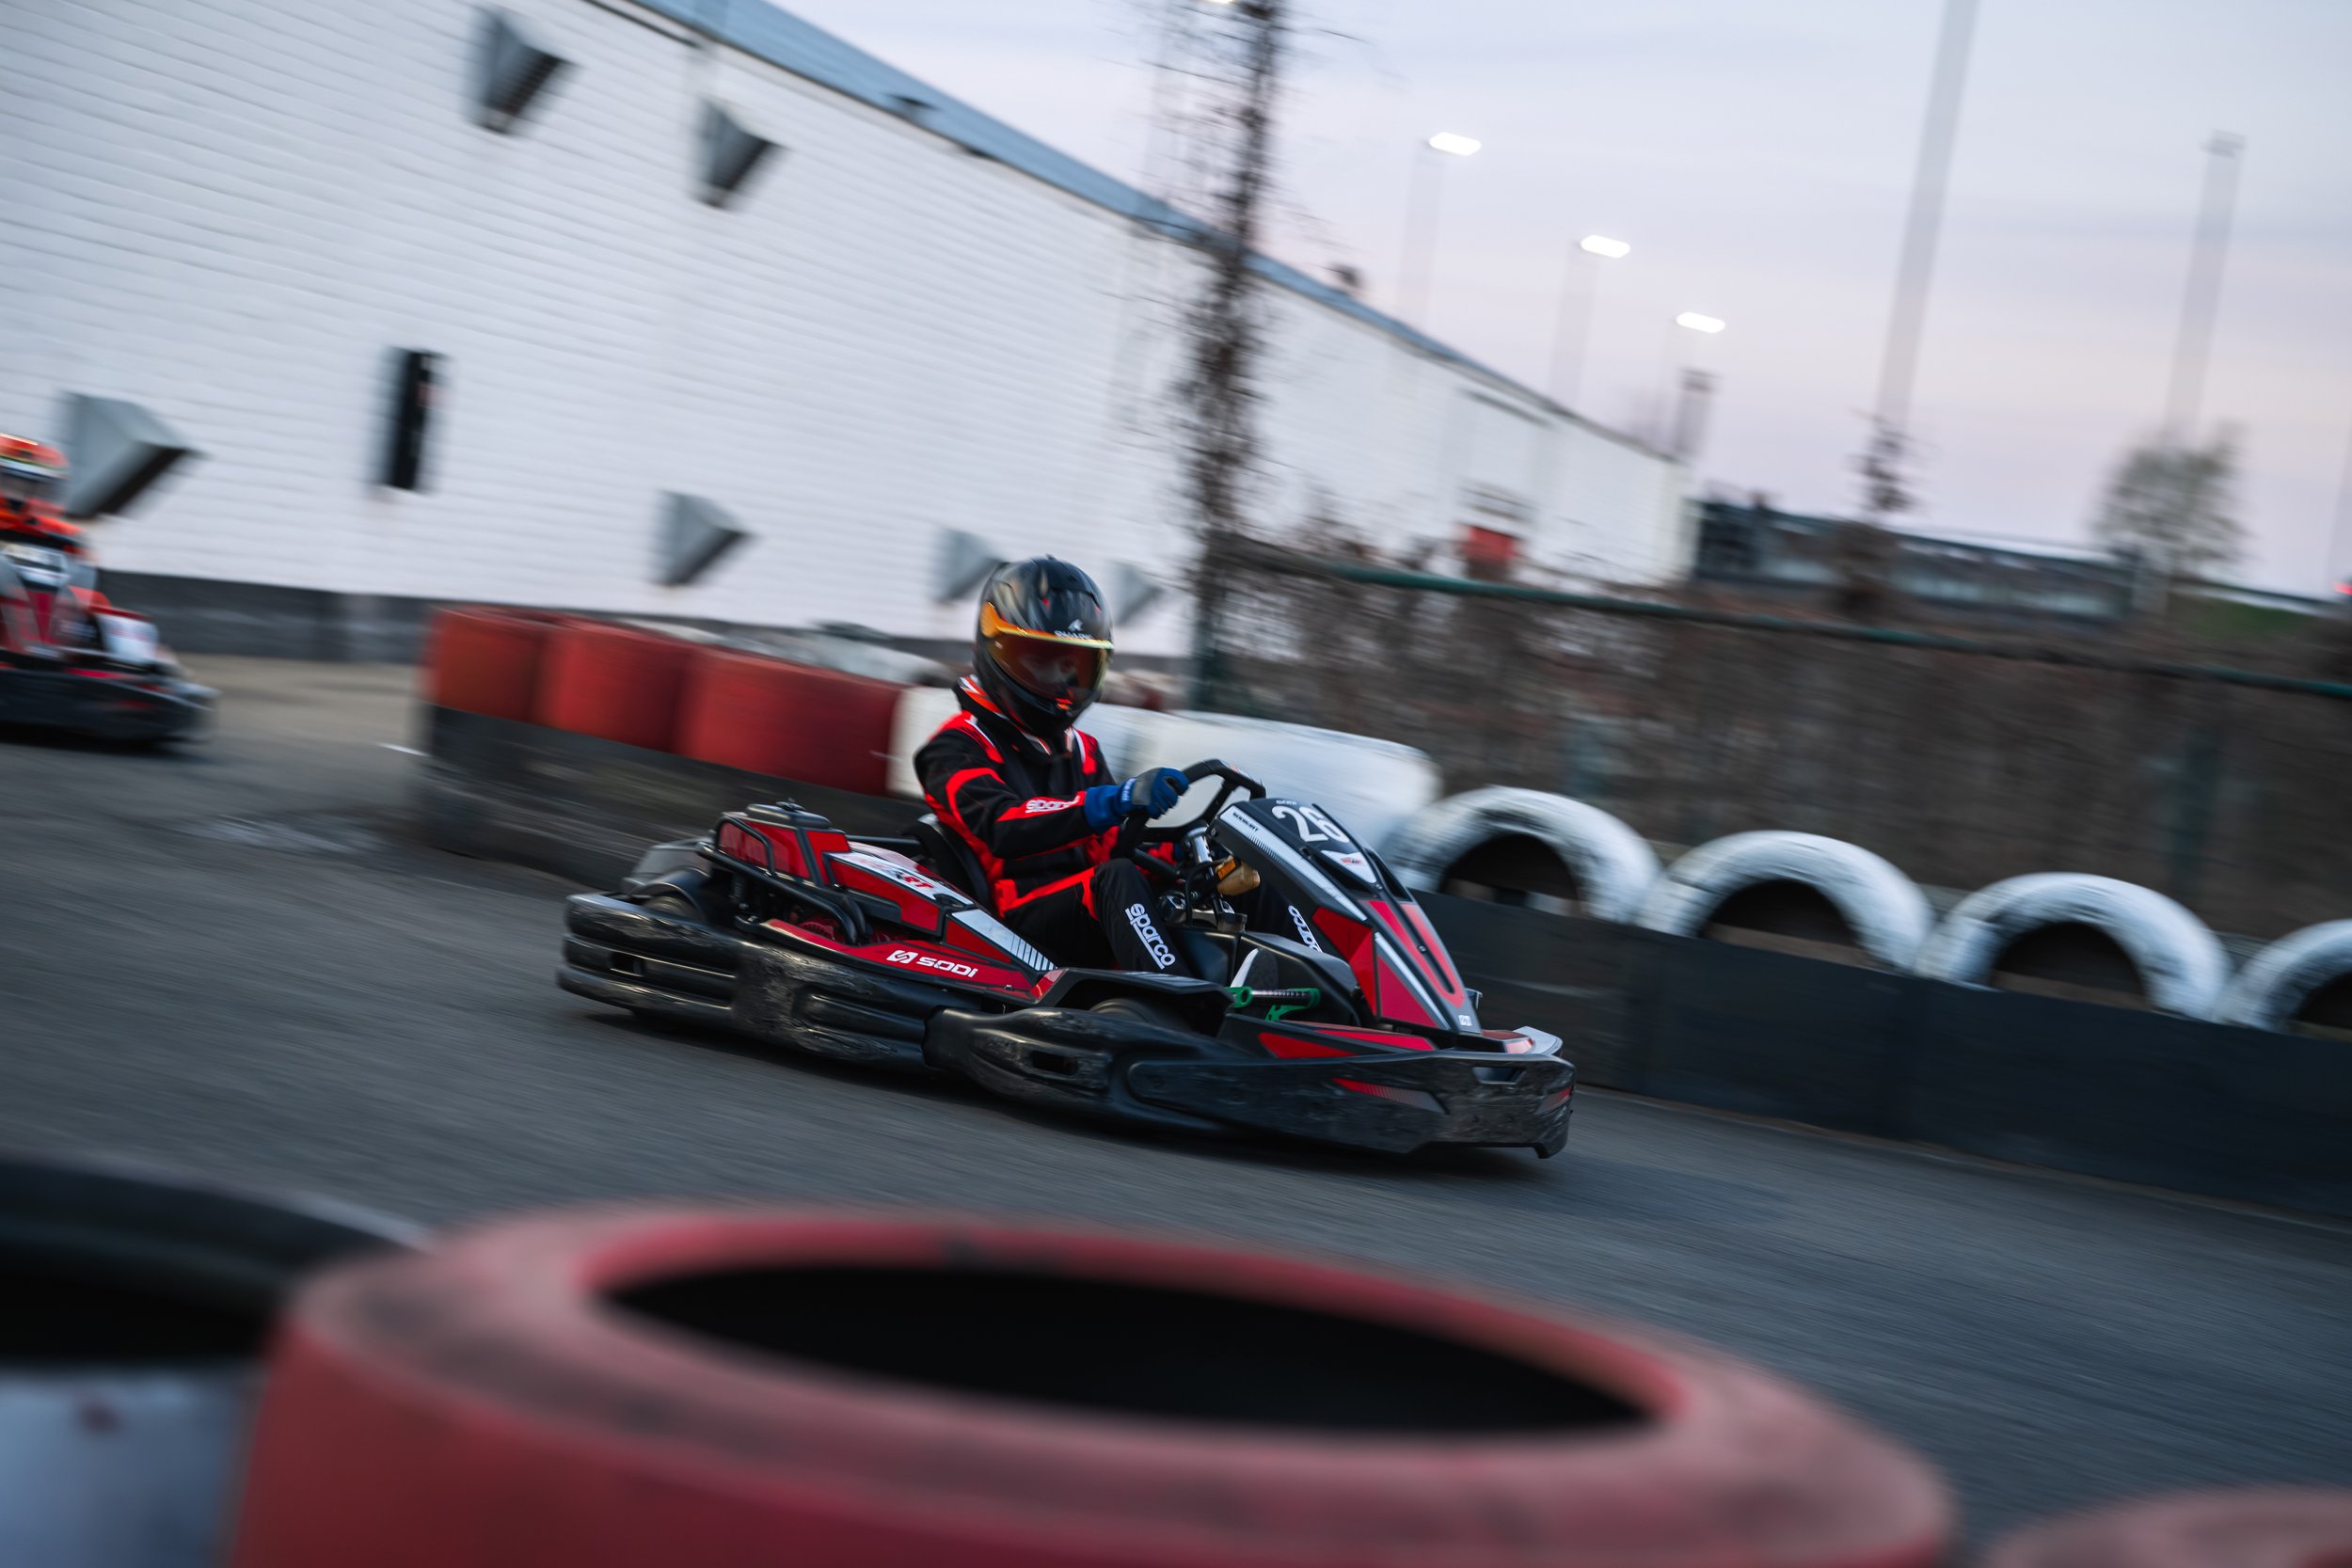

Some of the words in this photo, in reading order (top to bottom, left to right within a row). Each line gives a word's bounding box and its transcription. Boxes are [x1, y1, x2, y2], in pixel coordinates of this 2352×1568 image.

[1271, 805, 1350, 843] 26
[1124, 903, 1176, 970] sparco
[1288, 905, 1323, 953] arco
[915, 956, 978, 978] SODI
